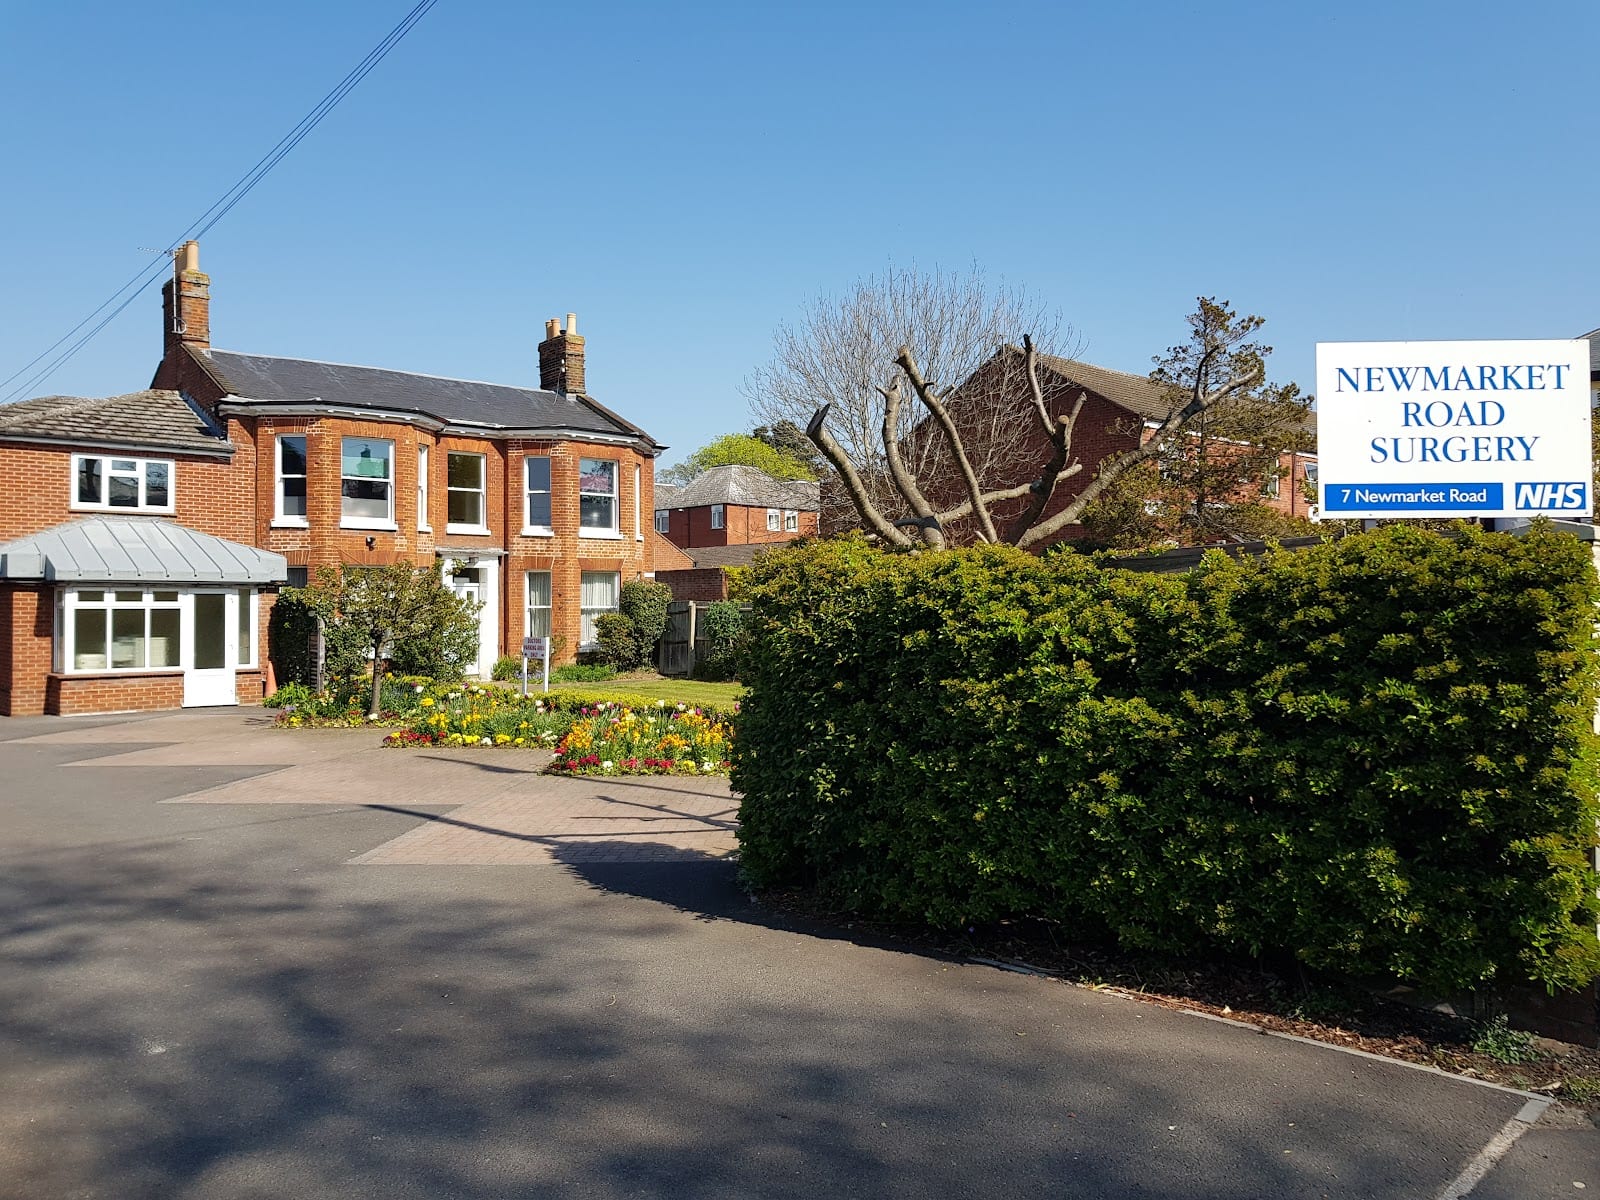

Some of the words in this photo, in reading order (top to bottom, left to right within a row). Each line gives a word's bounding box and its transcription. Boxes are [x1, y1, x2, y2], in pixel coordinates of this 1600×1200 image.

[1335, 364, 1570, 392] NEWMARKET
[1401, 400, 1505, 427] ROAD
[1370, 436, 1540, 463] SURGERY
[1341, 489, 1350, 503] 7
[1355, 489, 1445, 503] Newmarket
[1449, 489, 1487, 502] Road
[1517, 484, 1583, 508] NHS
